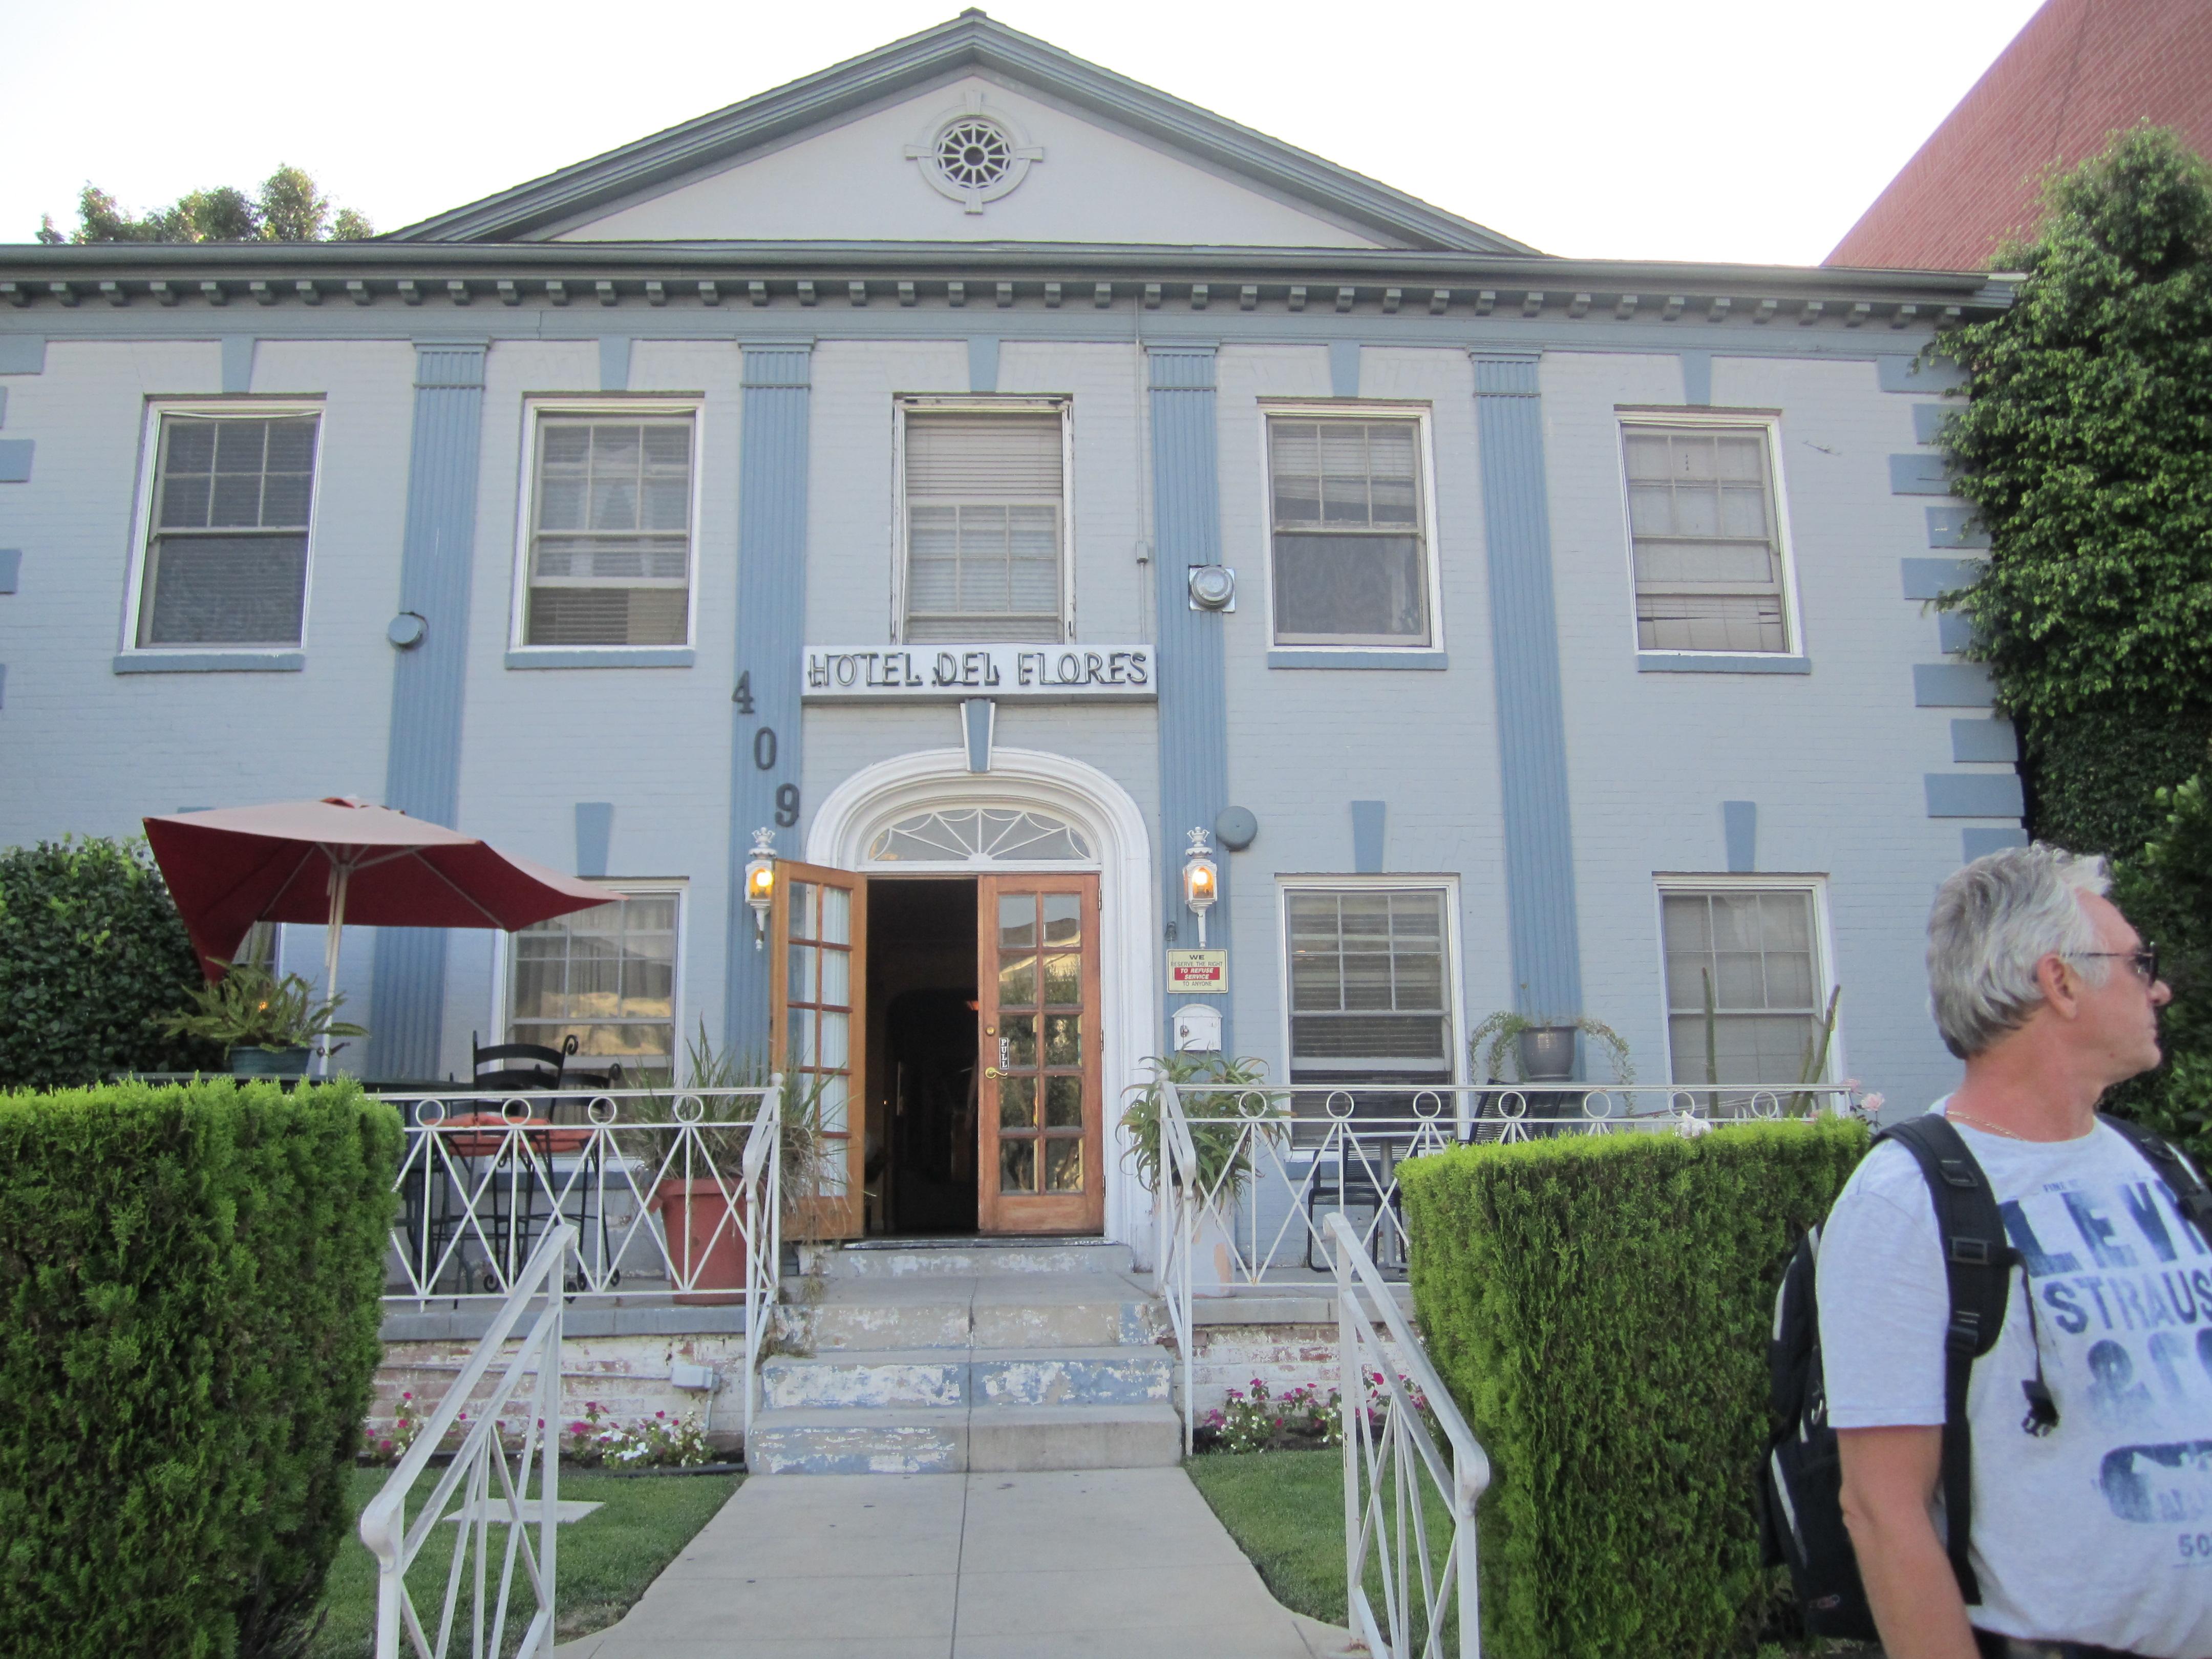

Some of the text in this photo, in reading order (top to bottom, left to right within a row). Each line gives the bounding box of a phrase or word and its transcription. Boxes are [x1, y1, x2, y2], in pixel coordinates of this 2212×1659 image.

[808, 651, 1147, 687] HOTEL DEL FLORES
[2043, 1266, 2212, 1334] STRAUS
